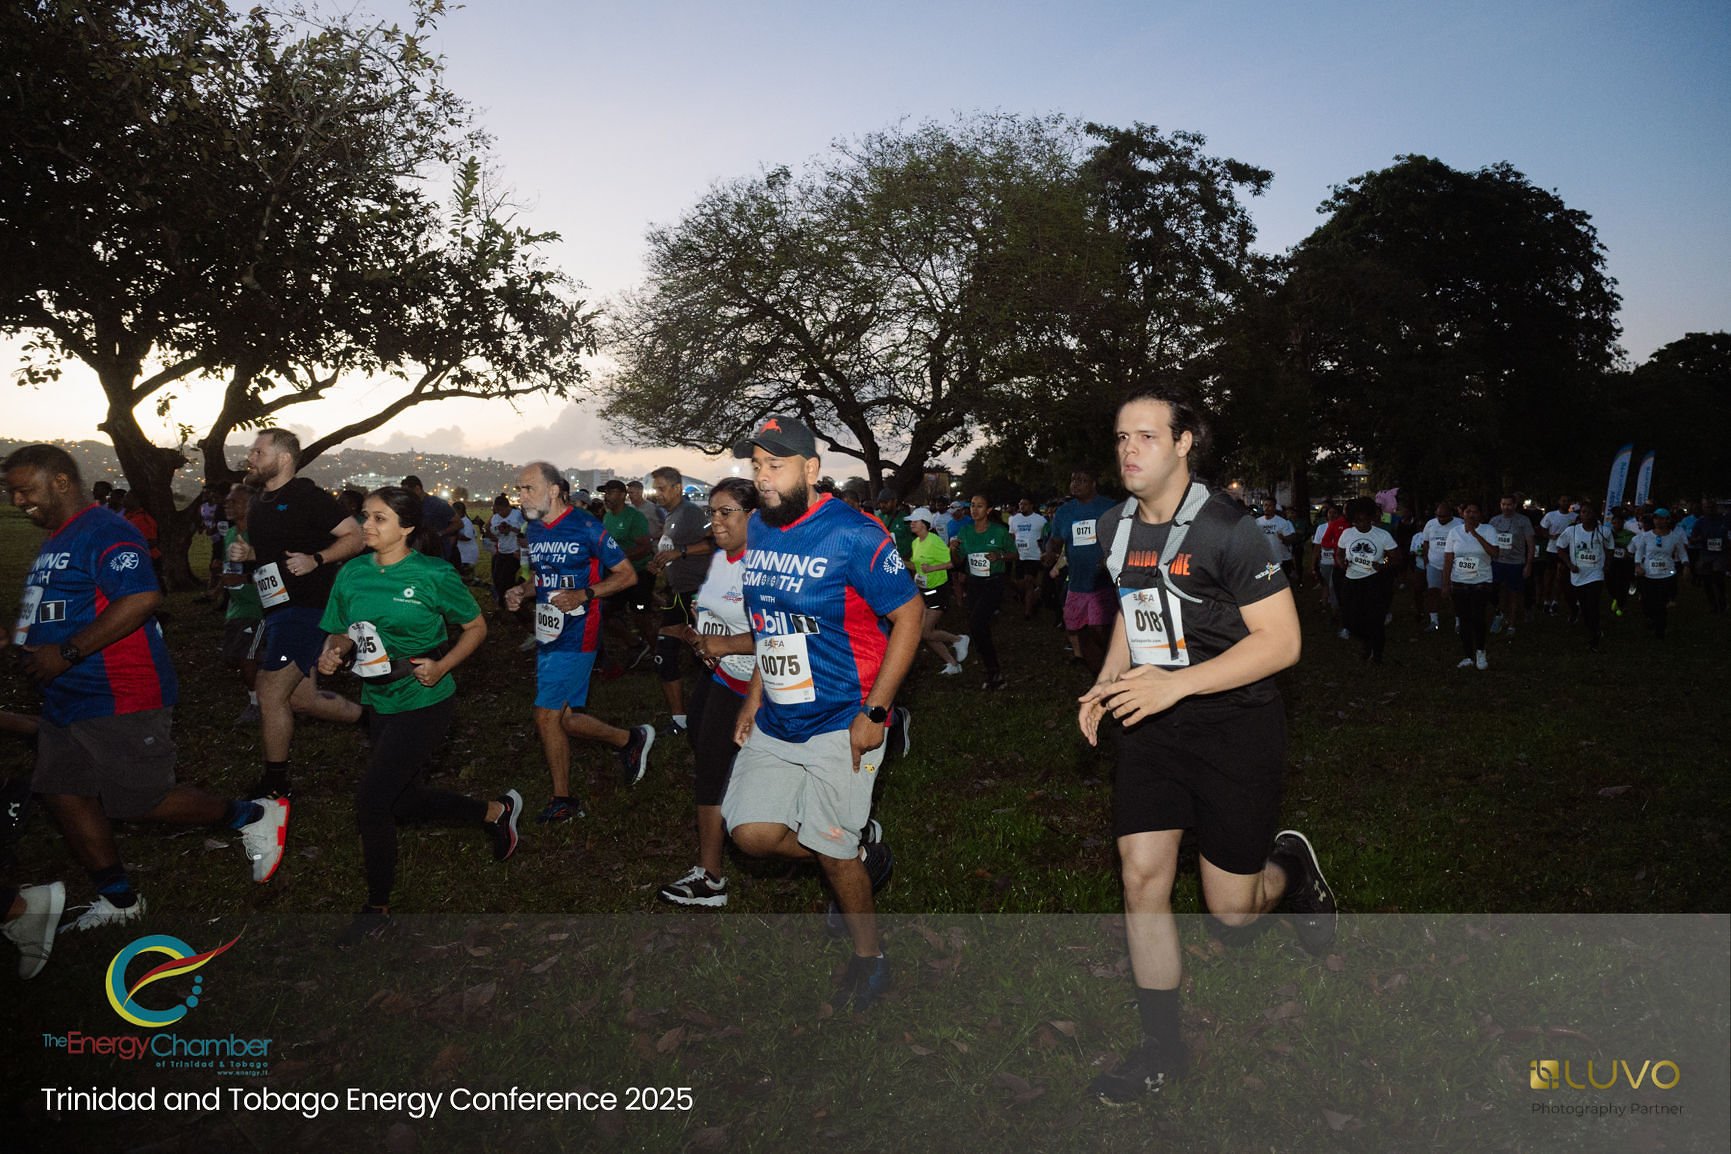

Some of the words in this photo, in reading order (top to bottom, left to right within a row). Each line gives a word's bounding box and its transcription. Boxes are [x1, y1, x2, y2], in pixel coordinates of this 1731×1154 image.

[1076, 526, 1092, 535] 0171
[258, 575, 278, 591] 0078
[760, 594, 776, 604] WITH
[538, 612, 560, 630] 0082
[1135, 609, 1164, 632] 018
[761, 655, 801, 676] 0075
